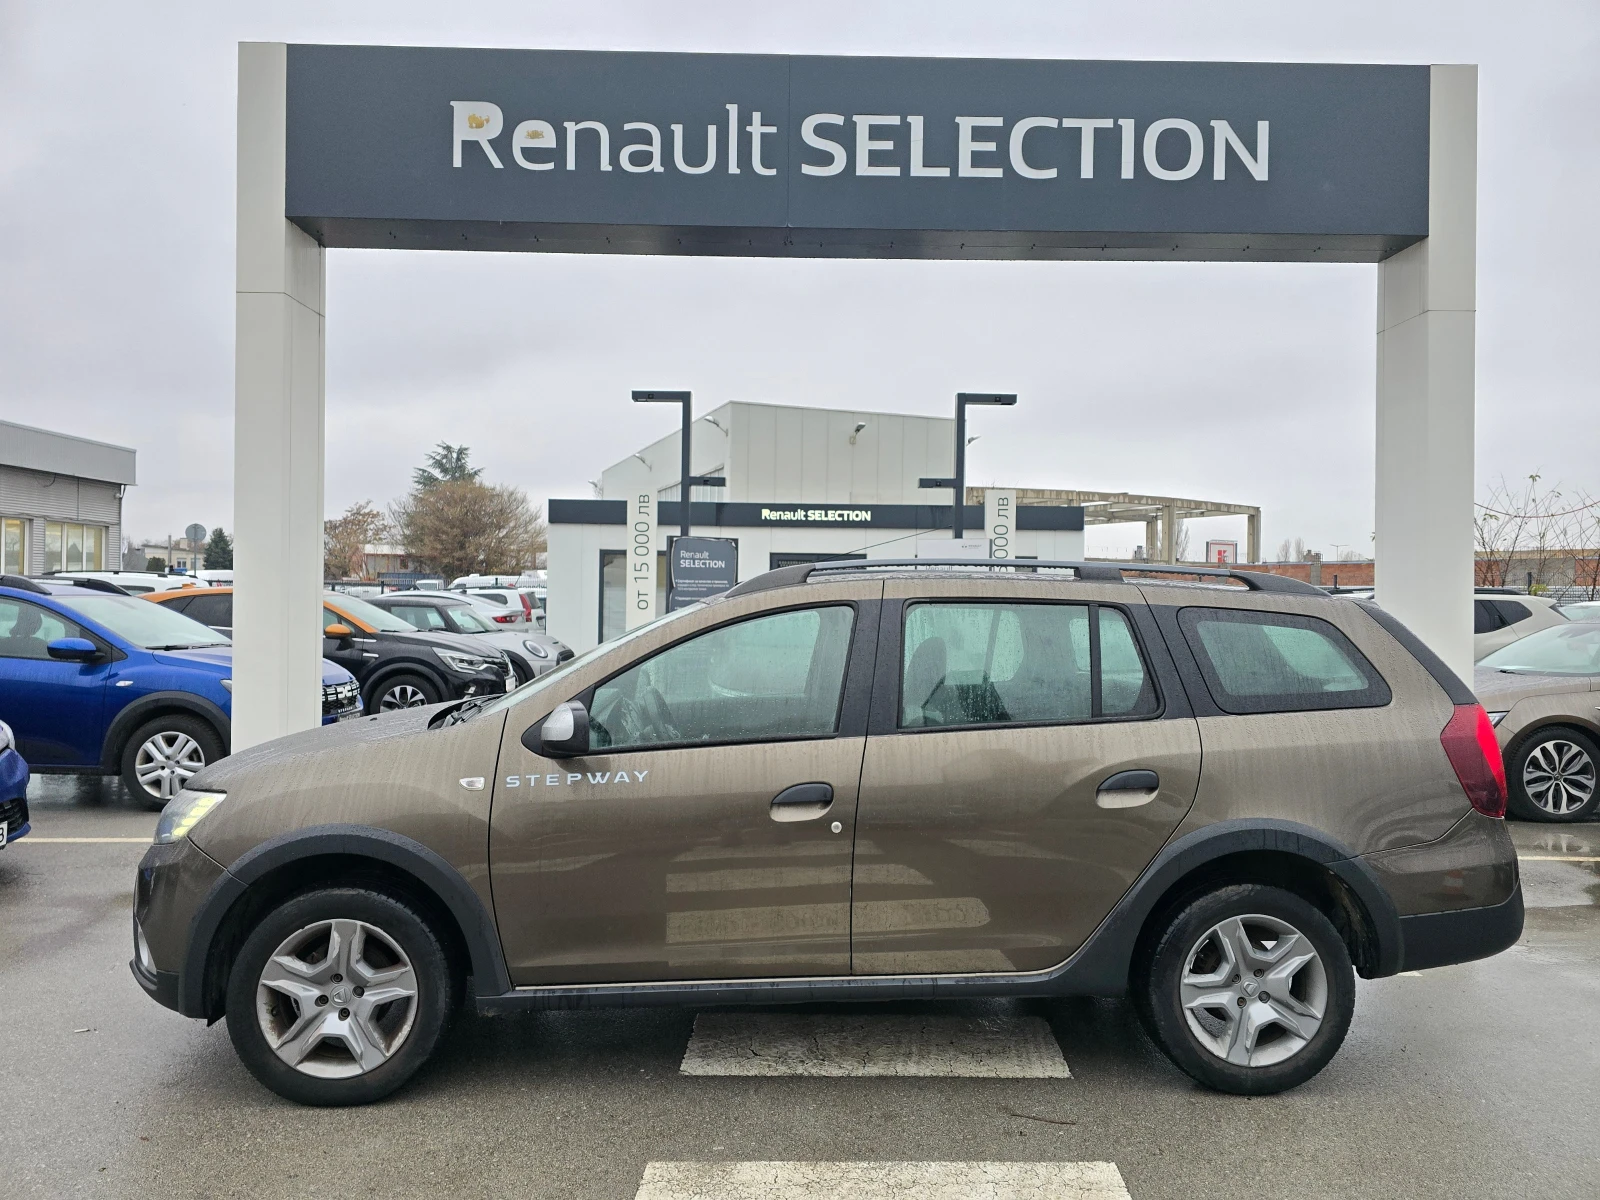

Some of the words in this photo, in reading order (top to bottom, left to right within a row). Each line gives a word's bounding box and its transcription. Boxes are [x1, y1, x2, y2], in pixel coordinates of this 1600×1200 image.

[449, 100, 778, 176] Renault
[800, 112, 1270, 181] SELECTION
[761, 508, 806, 521] Renault
[807, 509, 872, 522] SELECTION
[633, 521, 650, 557] 000
[680, 550, 710, 560] Renault
[680, 559, 726, 569] SELECTION
[633, 562, 650, 583] 15
[505, 770, 649, 788] STEPWAY
